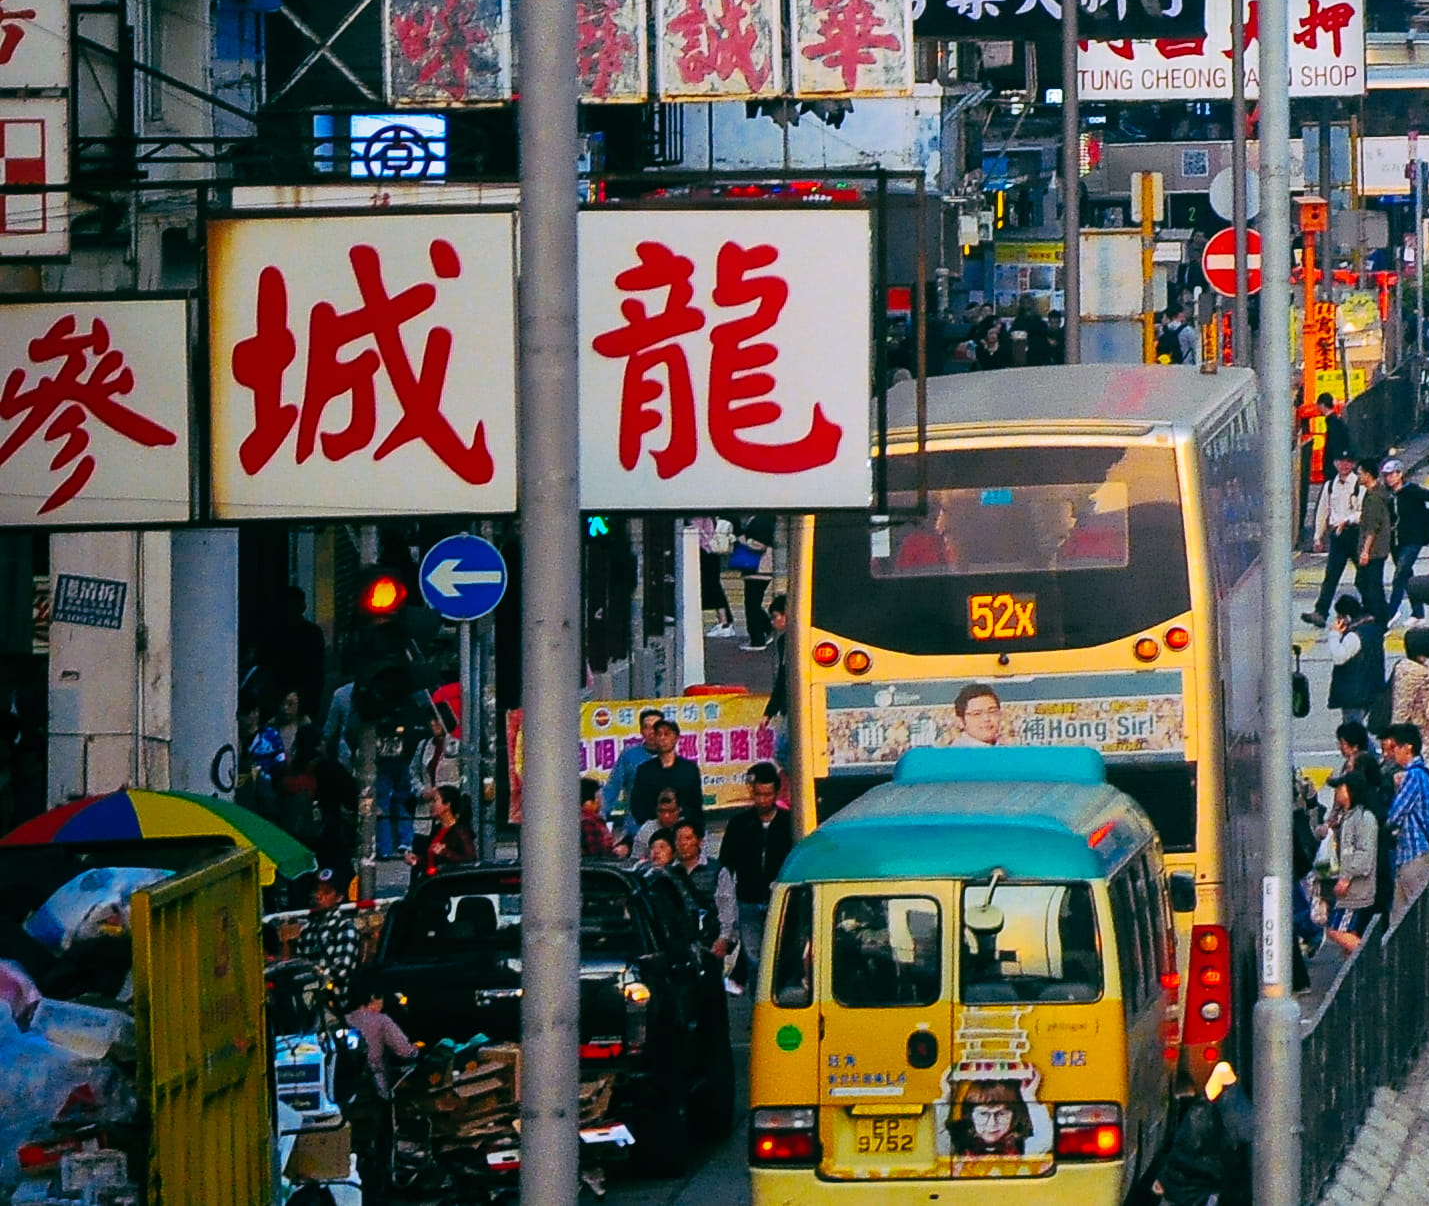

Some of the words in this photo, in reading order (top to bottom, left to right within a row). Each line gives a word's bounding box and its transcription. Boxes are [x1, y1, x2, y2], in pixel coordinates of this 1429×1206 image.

[1078, 69, 1133, 90] TUNG
[1141, 67, 1227, 89] CHEONG
[1301, 65, 1356, 87] SHOP
